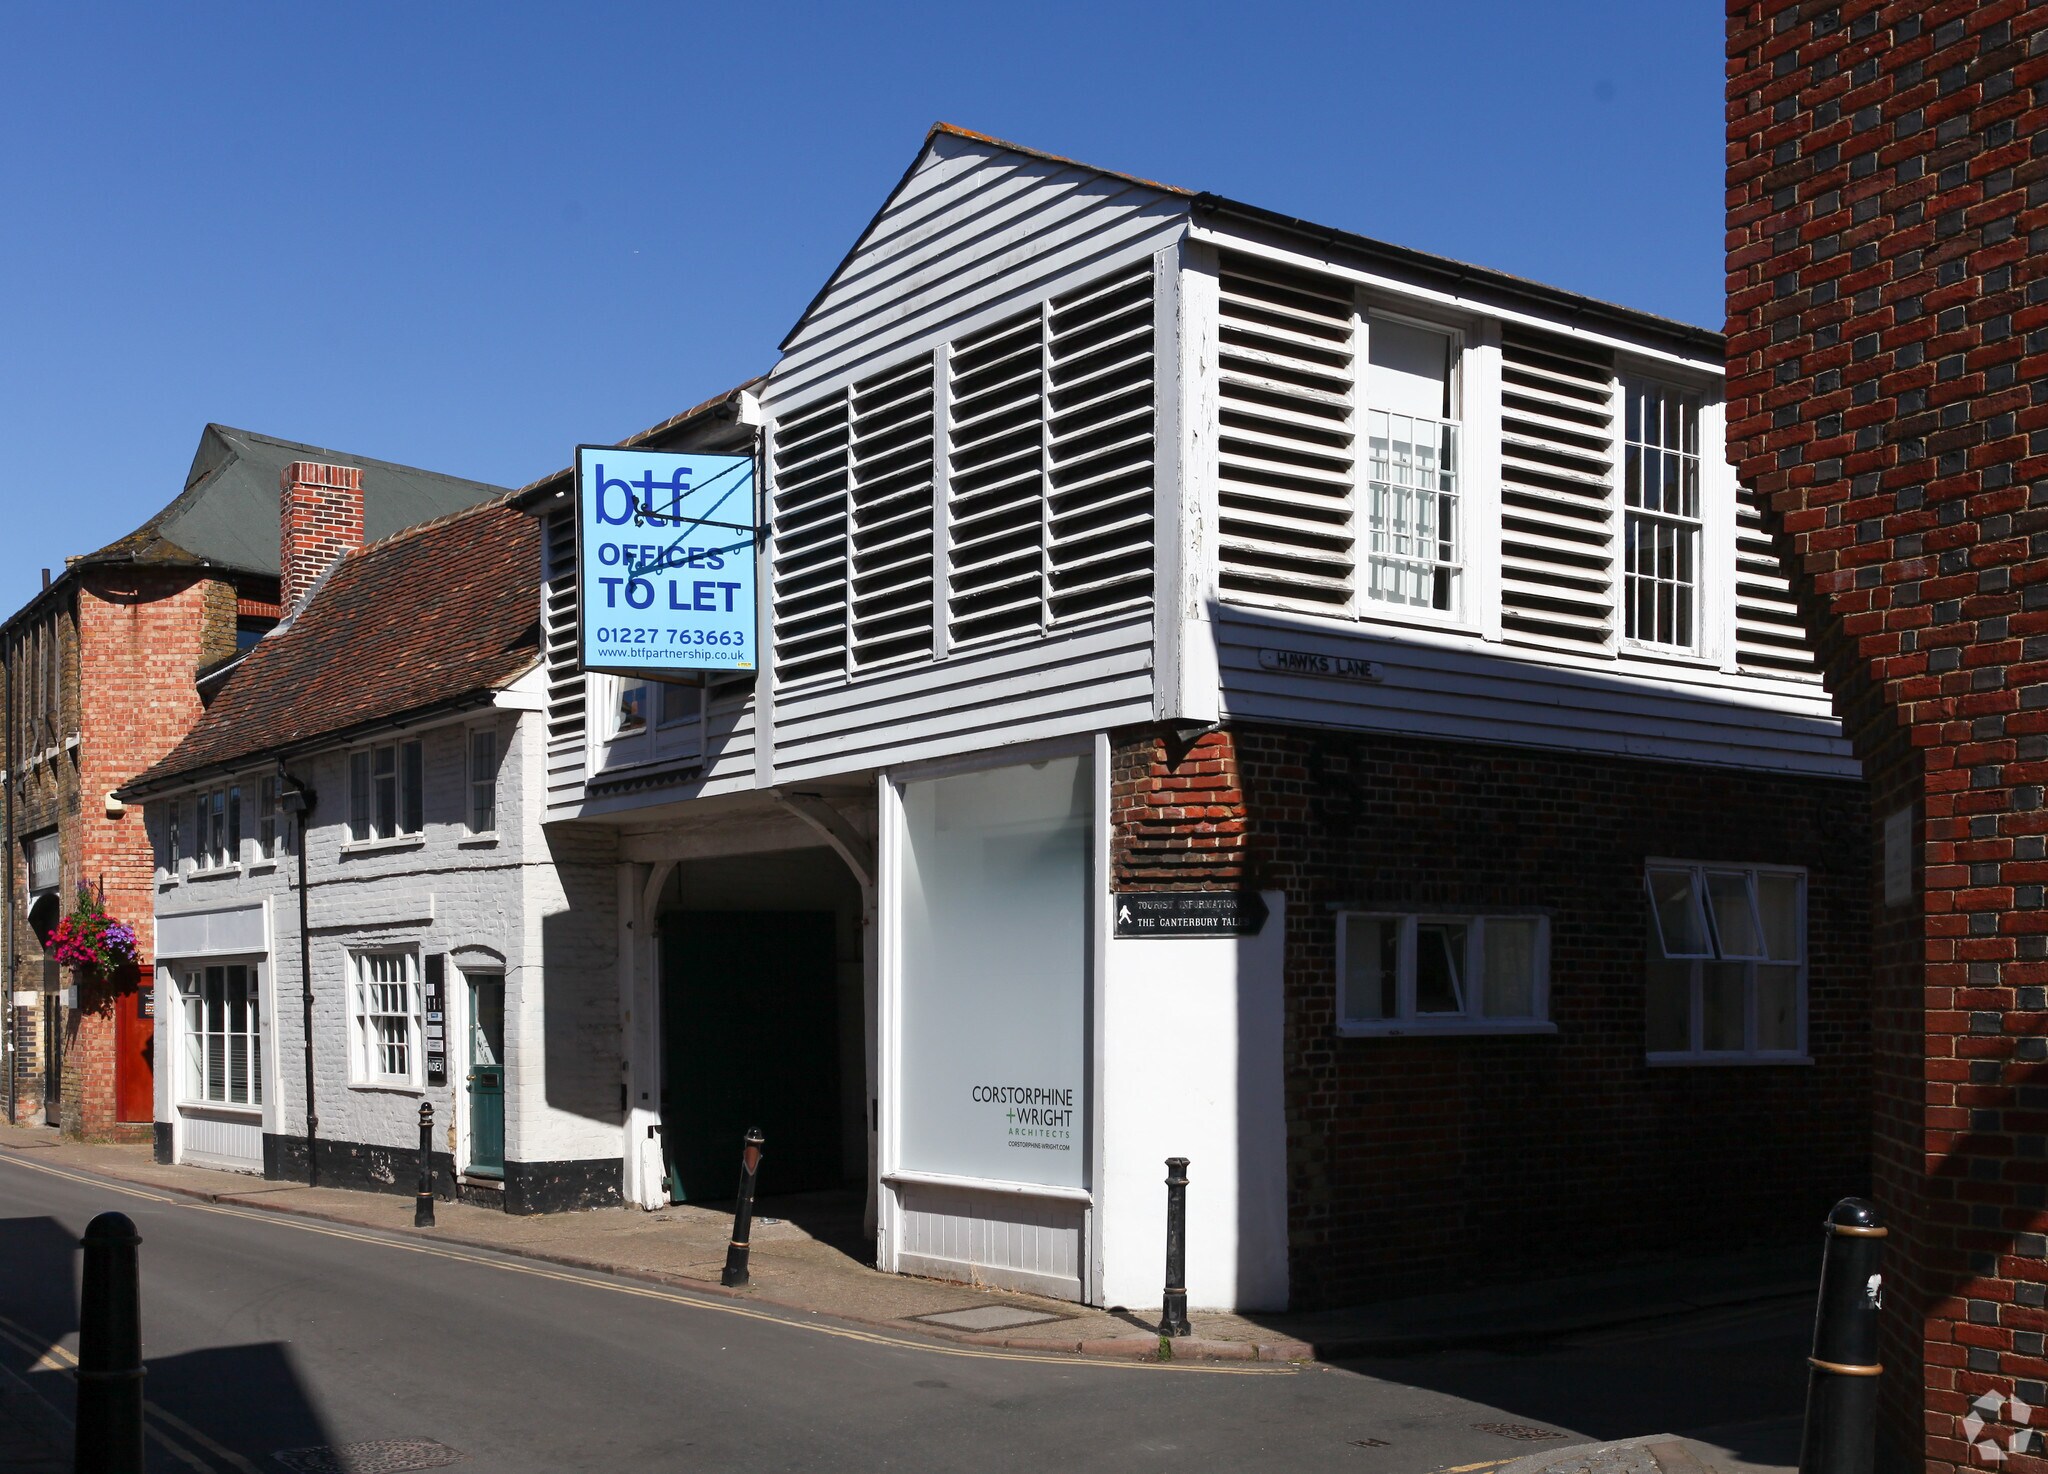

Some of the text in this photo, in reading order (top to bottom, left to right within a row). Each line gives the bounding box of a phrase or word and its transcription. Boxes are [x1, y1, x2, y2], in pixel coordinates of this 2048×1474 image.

[595, 464, 692, 527] btf
[598, 543, 725, 570] OFFICES
[598, 577, 741, 612] TO LET
[597, 627, 744, 646] 01227 763663
[598, 647, 744, 661] www.btfpartnership.co.uk
[1277, 652, 1372, 677] HAWKS LANE
[1137, 900, 1238, 910] TOURIST INFORMATION
[1138, 918, 1155, 927] THE
[1160, 917, 1218, 927] CANTERBURY
[972, 1085, 1073, 1106] CORSTORPHINE
[1008, 1128, 1070, 1138] ARCHITECTS
